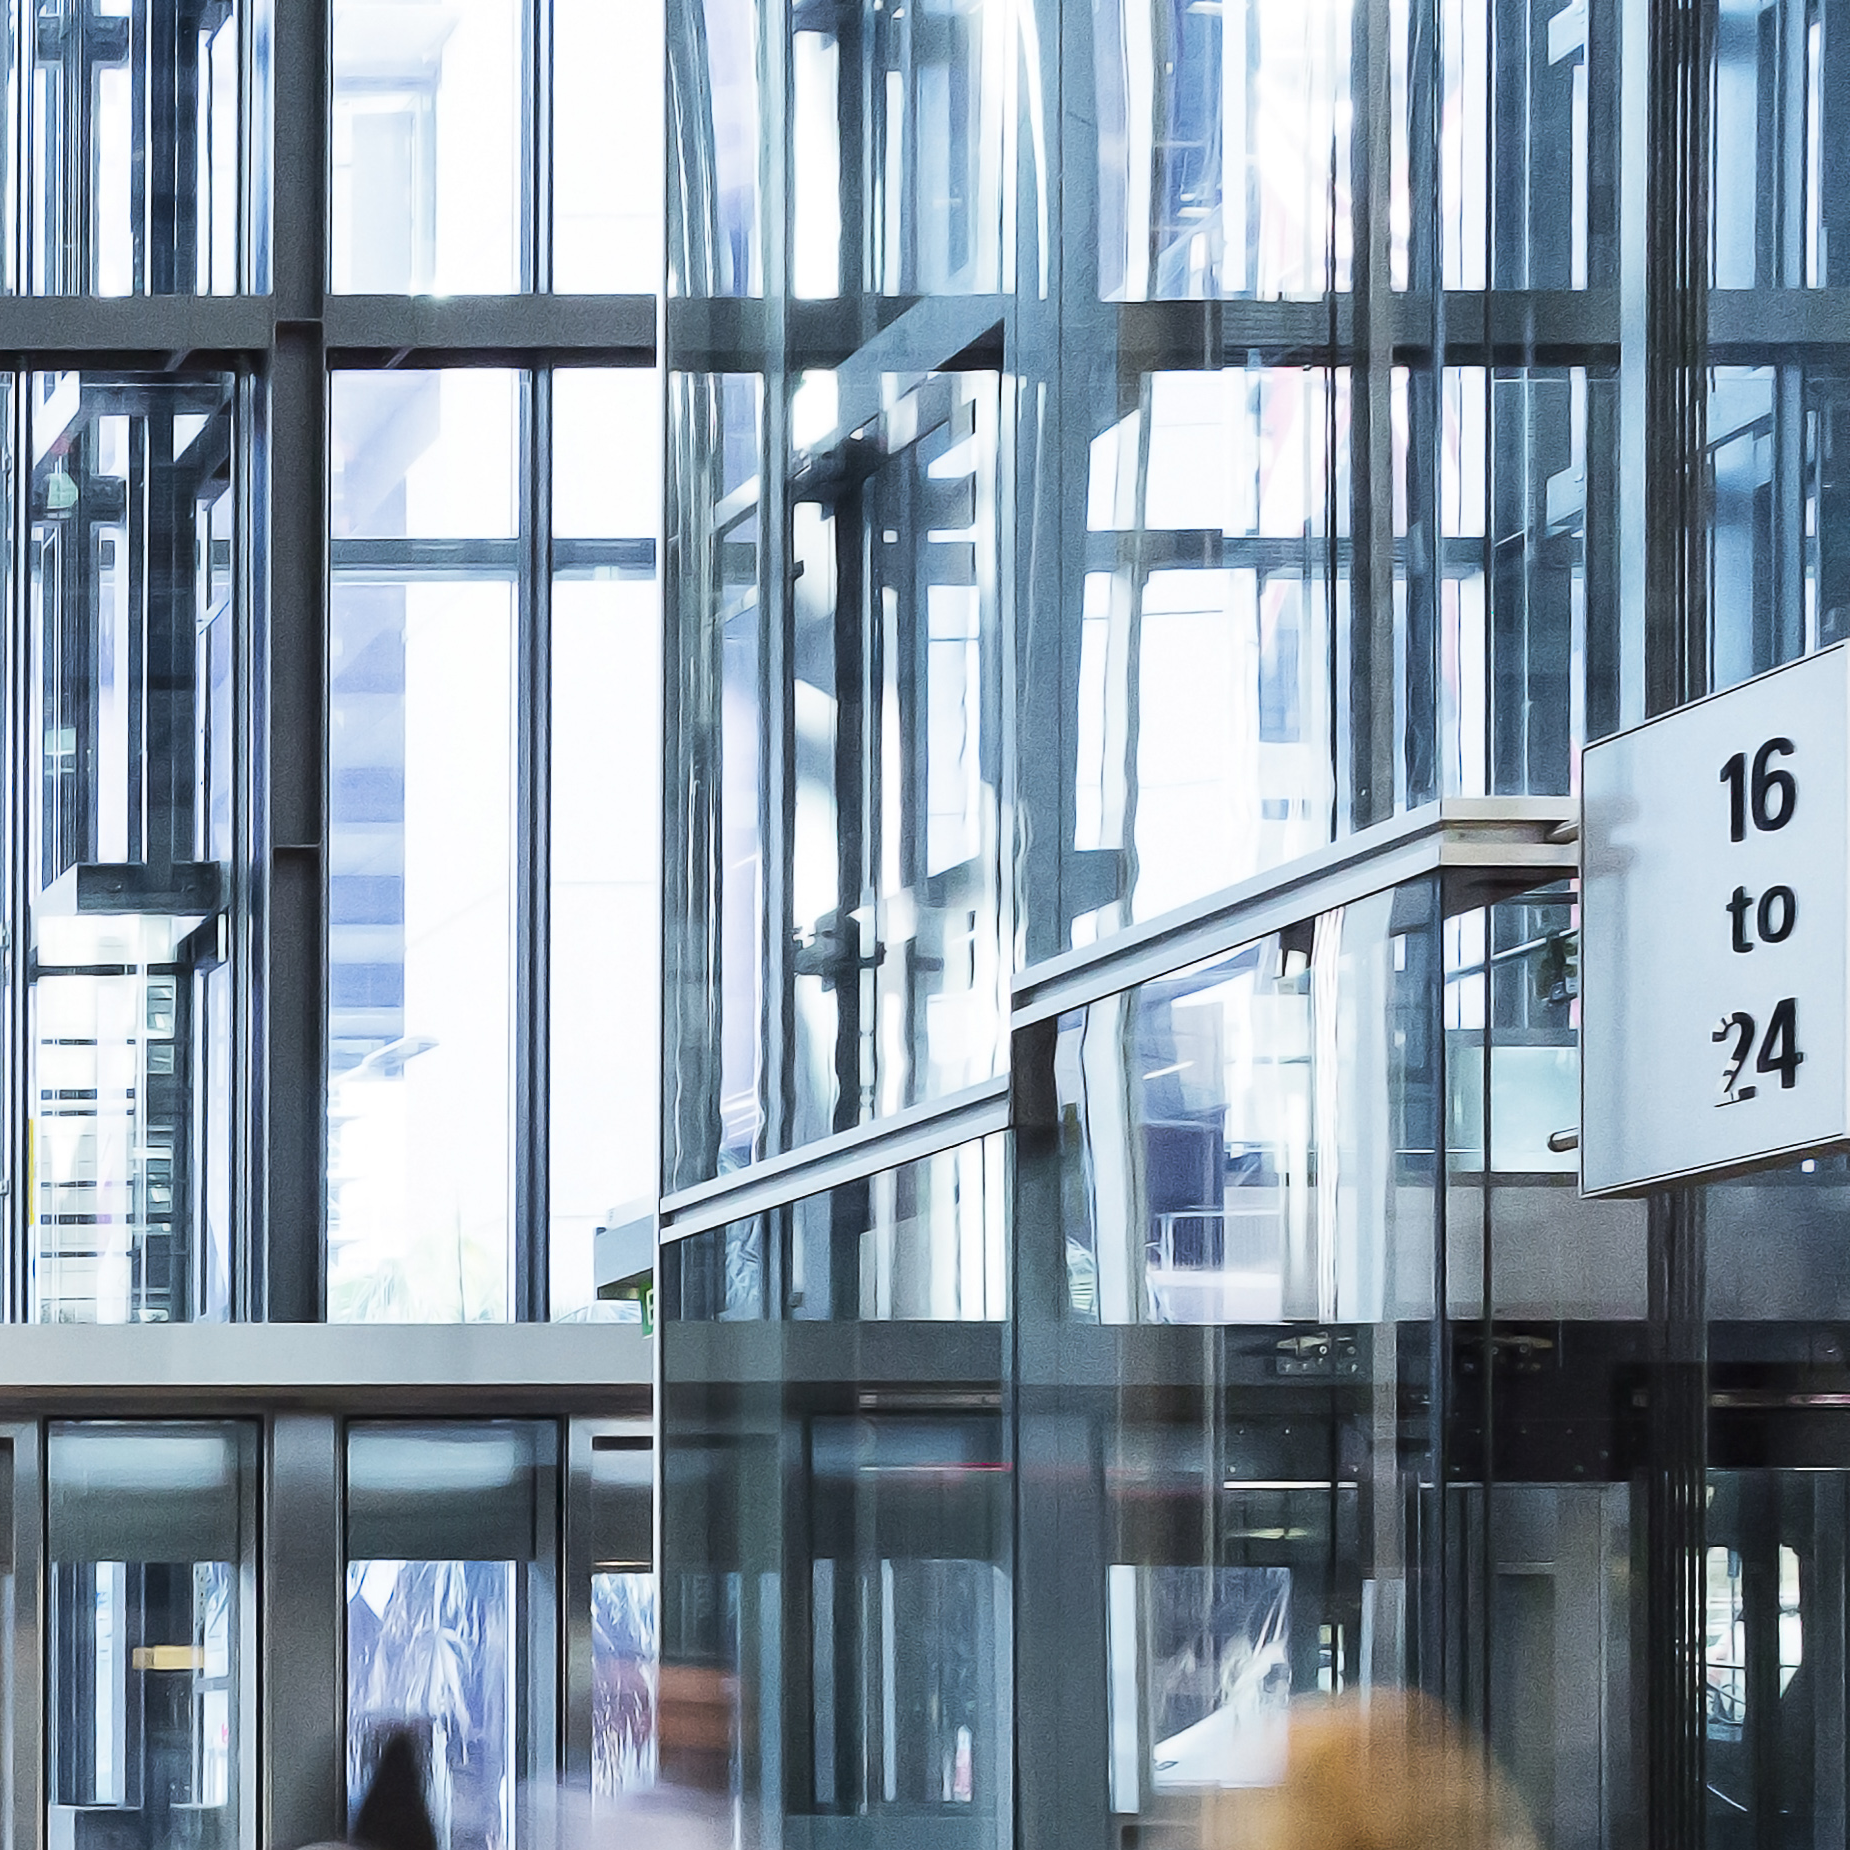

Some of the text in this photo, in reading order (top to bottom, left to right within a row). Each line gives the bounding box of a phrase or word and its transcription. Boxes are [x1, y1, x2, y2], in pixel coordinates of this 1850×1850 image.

[1719, 737, 1797, 843] 16
[1725, 885, 1796, 954] to
[1711, 997, 1804, 1108] 24
